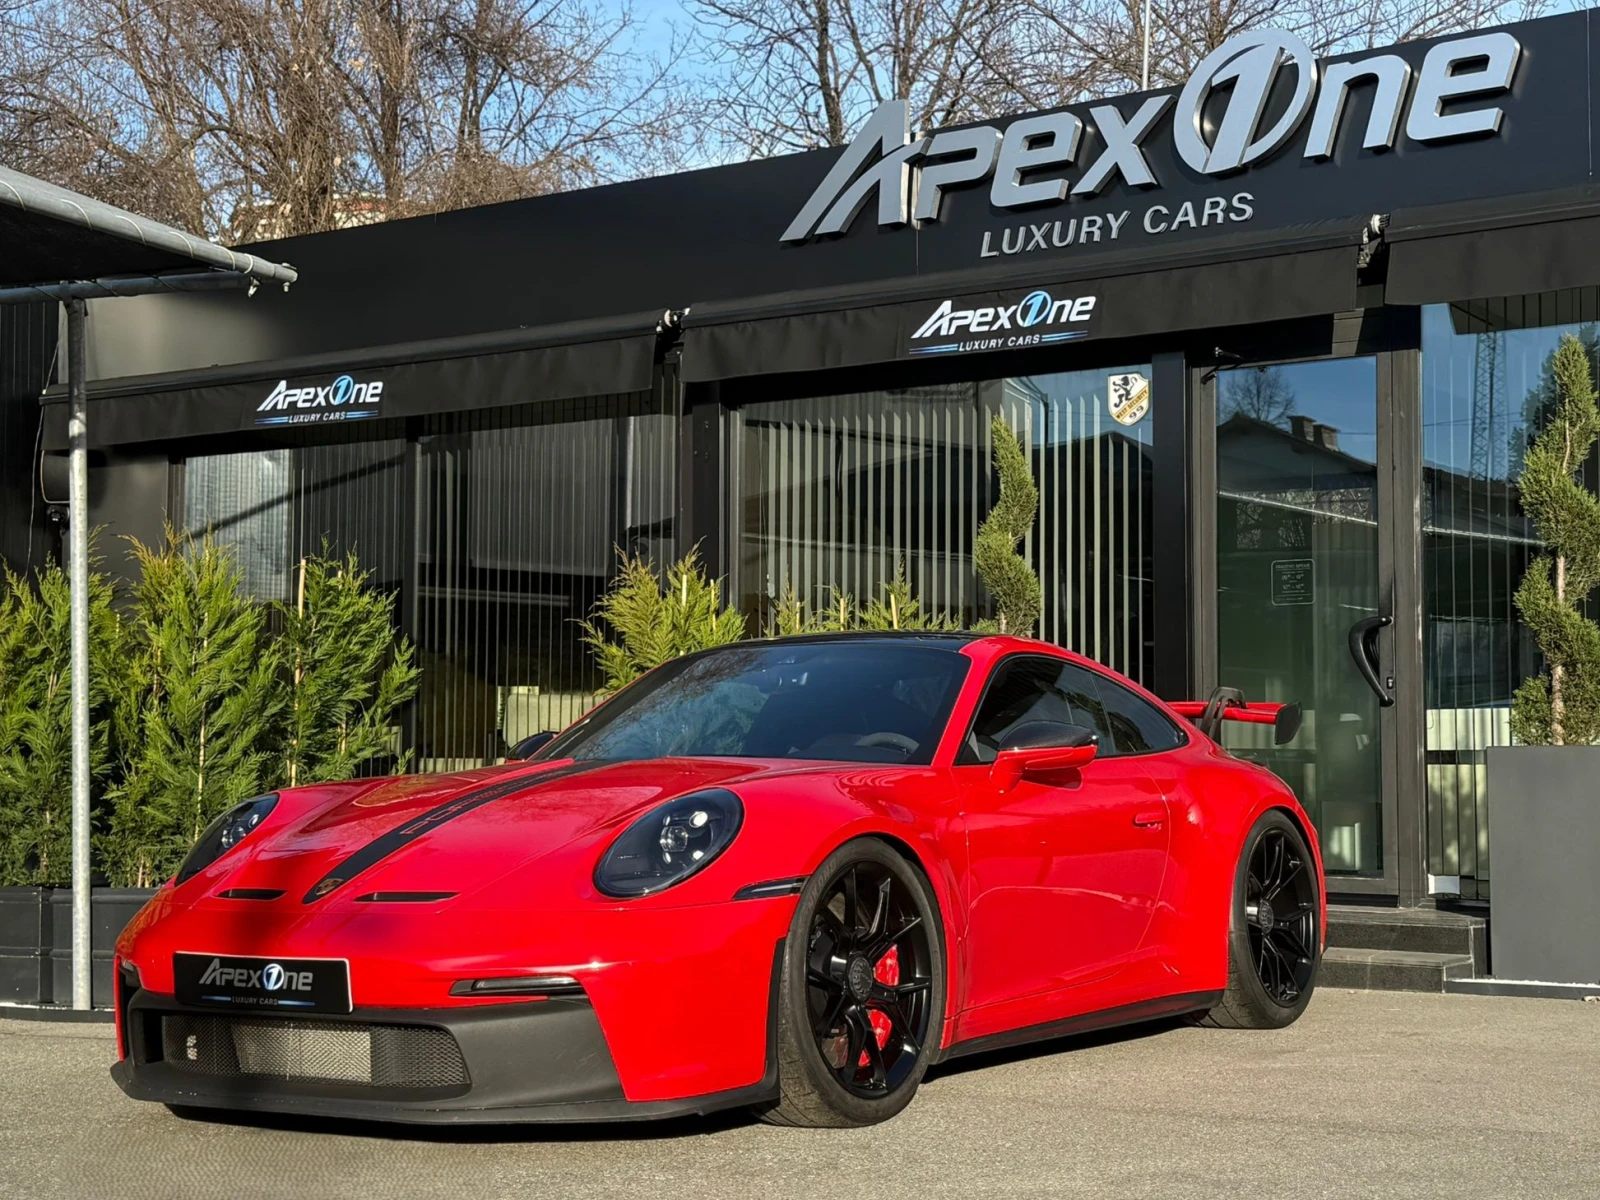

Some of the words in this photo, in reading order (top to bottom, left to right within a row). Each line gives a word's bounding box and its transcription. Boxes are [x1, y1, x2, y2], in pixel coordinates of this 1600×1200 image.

[979, 209, 1131, 258] LUXURY
[1143, 192, 1254, 234] CARS
[958, 337, 1004, 352] LUXURY
[1007, 334, 1040, 347] CARS
[288, 413, 320, 424] LUXURY
[323, 411, 346, 421] CARS
[1129, 405, 1144, 419] 99
[232, 996, 257, 1005] LUXURY
[259, 997, 278, 1006] CARS
